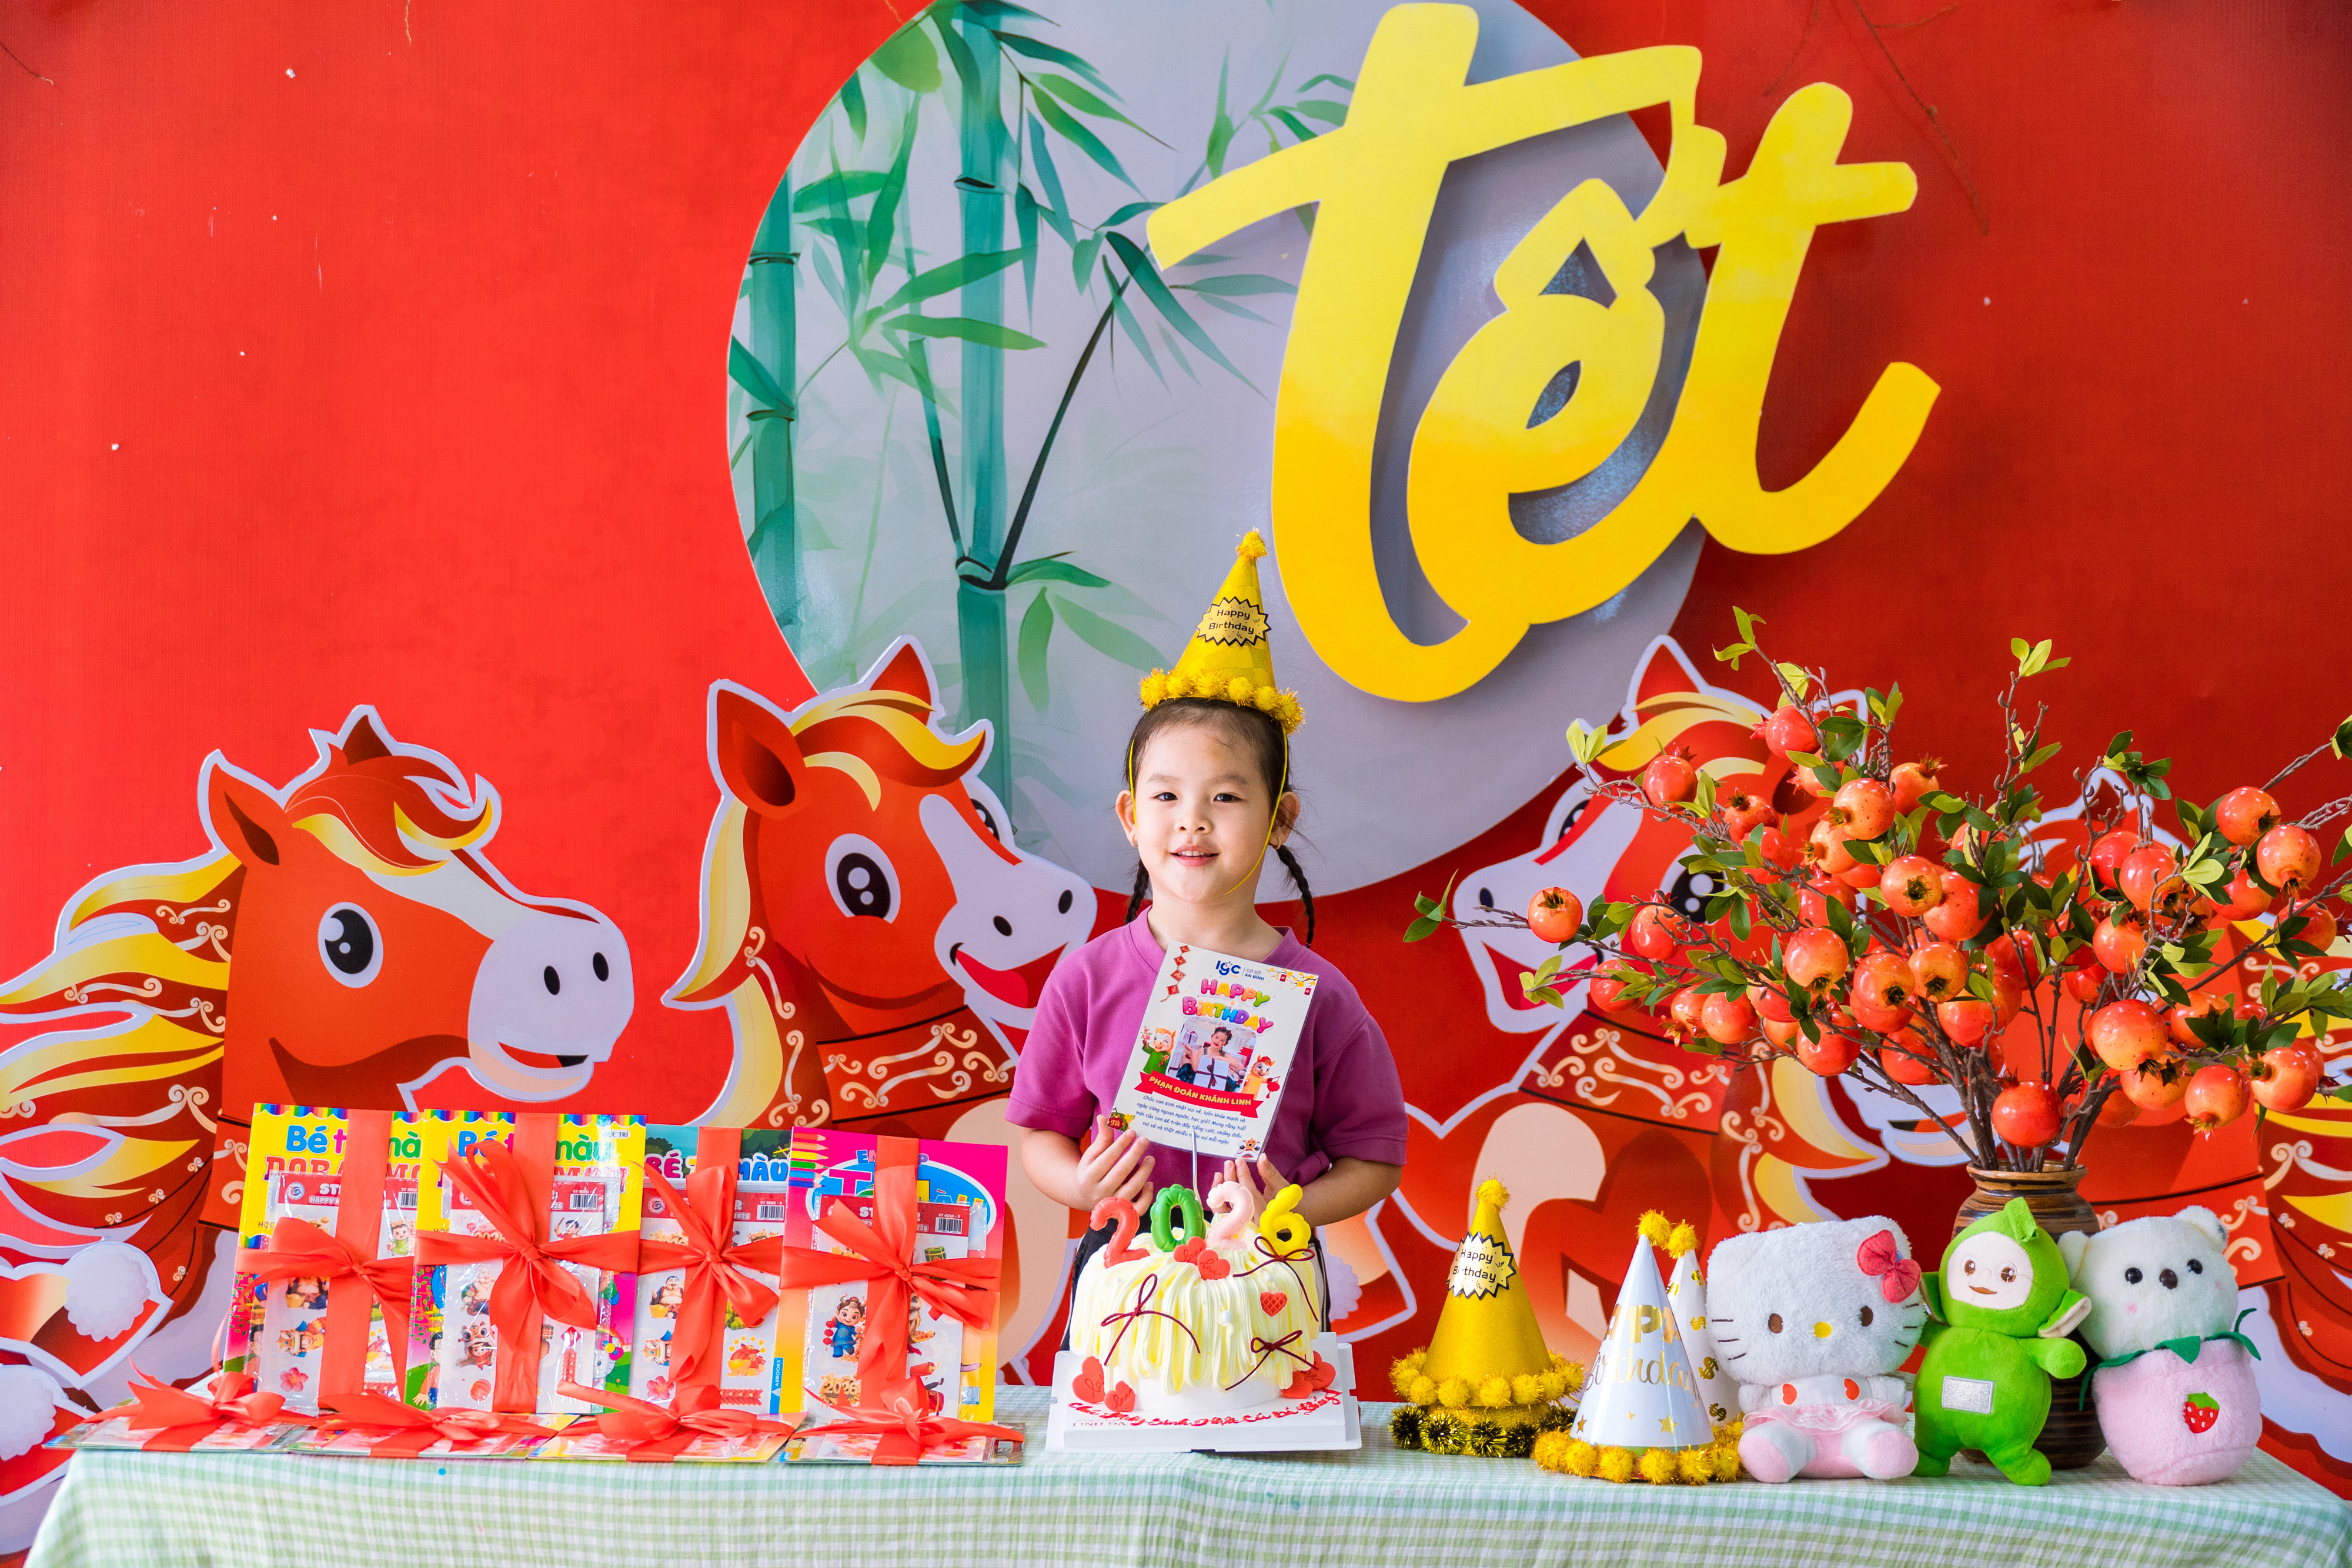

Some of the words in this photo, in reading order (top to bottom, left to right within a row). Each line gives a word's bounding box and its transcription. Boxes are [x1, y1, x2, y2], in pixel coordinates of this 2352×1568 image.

[1145, 1, 1942, 703] Tết
[1217, 609, 1251, 620] Happy
[1209, 621, 1254, 635] Birthday
[1201, 978, 1270, 1007] HAPPY
[1149, 1076, 1173, 1091] PHẠM
[1174, 1086, 1198, 1099] ĐOÀN
[1200, 1094, 1230, 1104] KHÁNH
[286, 1125, 328, 1154] Bé
[1460, 1248, 1494, 1264] Happy
[1452, 1265, 1496, 1283] Bithday
